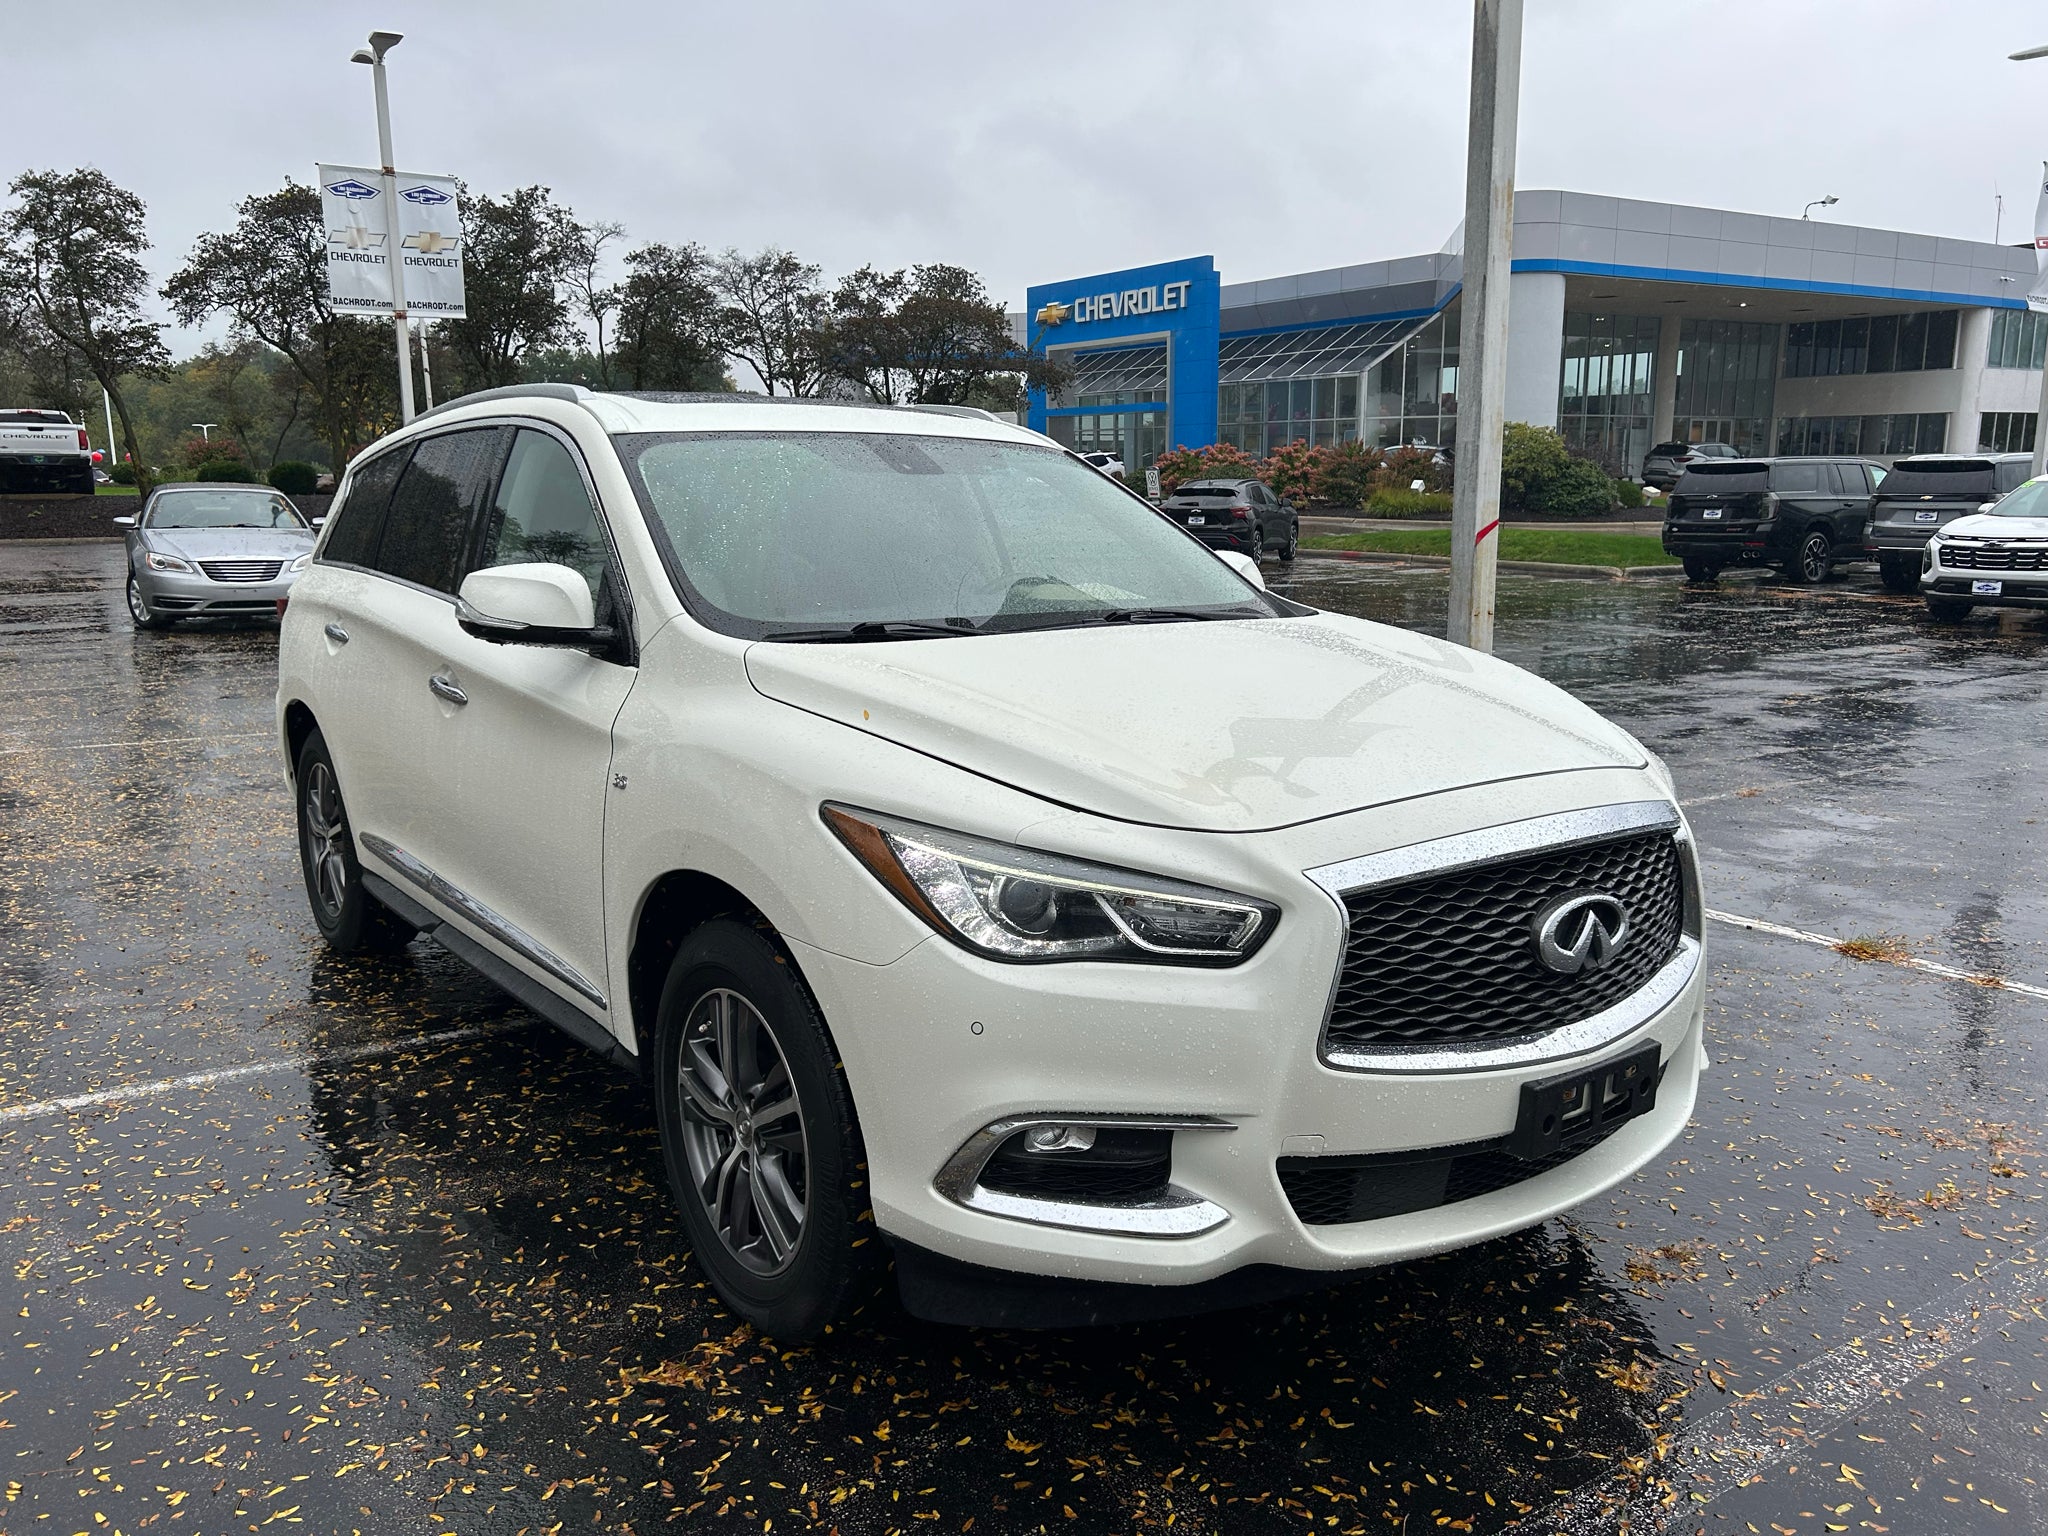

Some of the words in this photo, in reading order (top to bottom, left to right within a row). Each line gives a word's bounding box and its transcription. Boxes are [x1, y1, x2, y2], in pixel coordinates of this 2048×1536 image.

[331, 252, 386, 264] CHEVROLET
[404, 256, 459, 268] CHEVROLET
[332, 297, 393, 308] BACHRODT.com
[406, 301, 464, 311] BACHRODT.com
[1074, 280, 1191, 323] CHEVROLET
